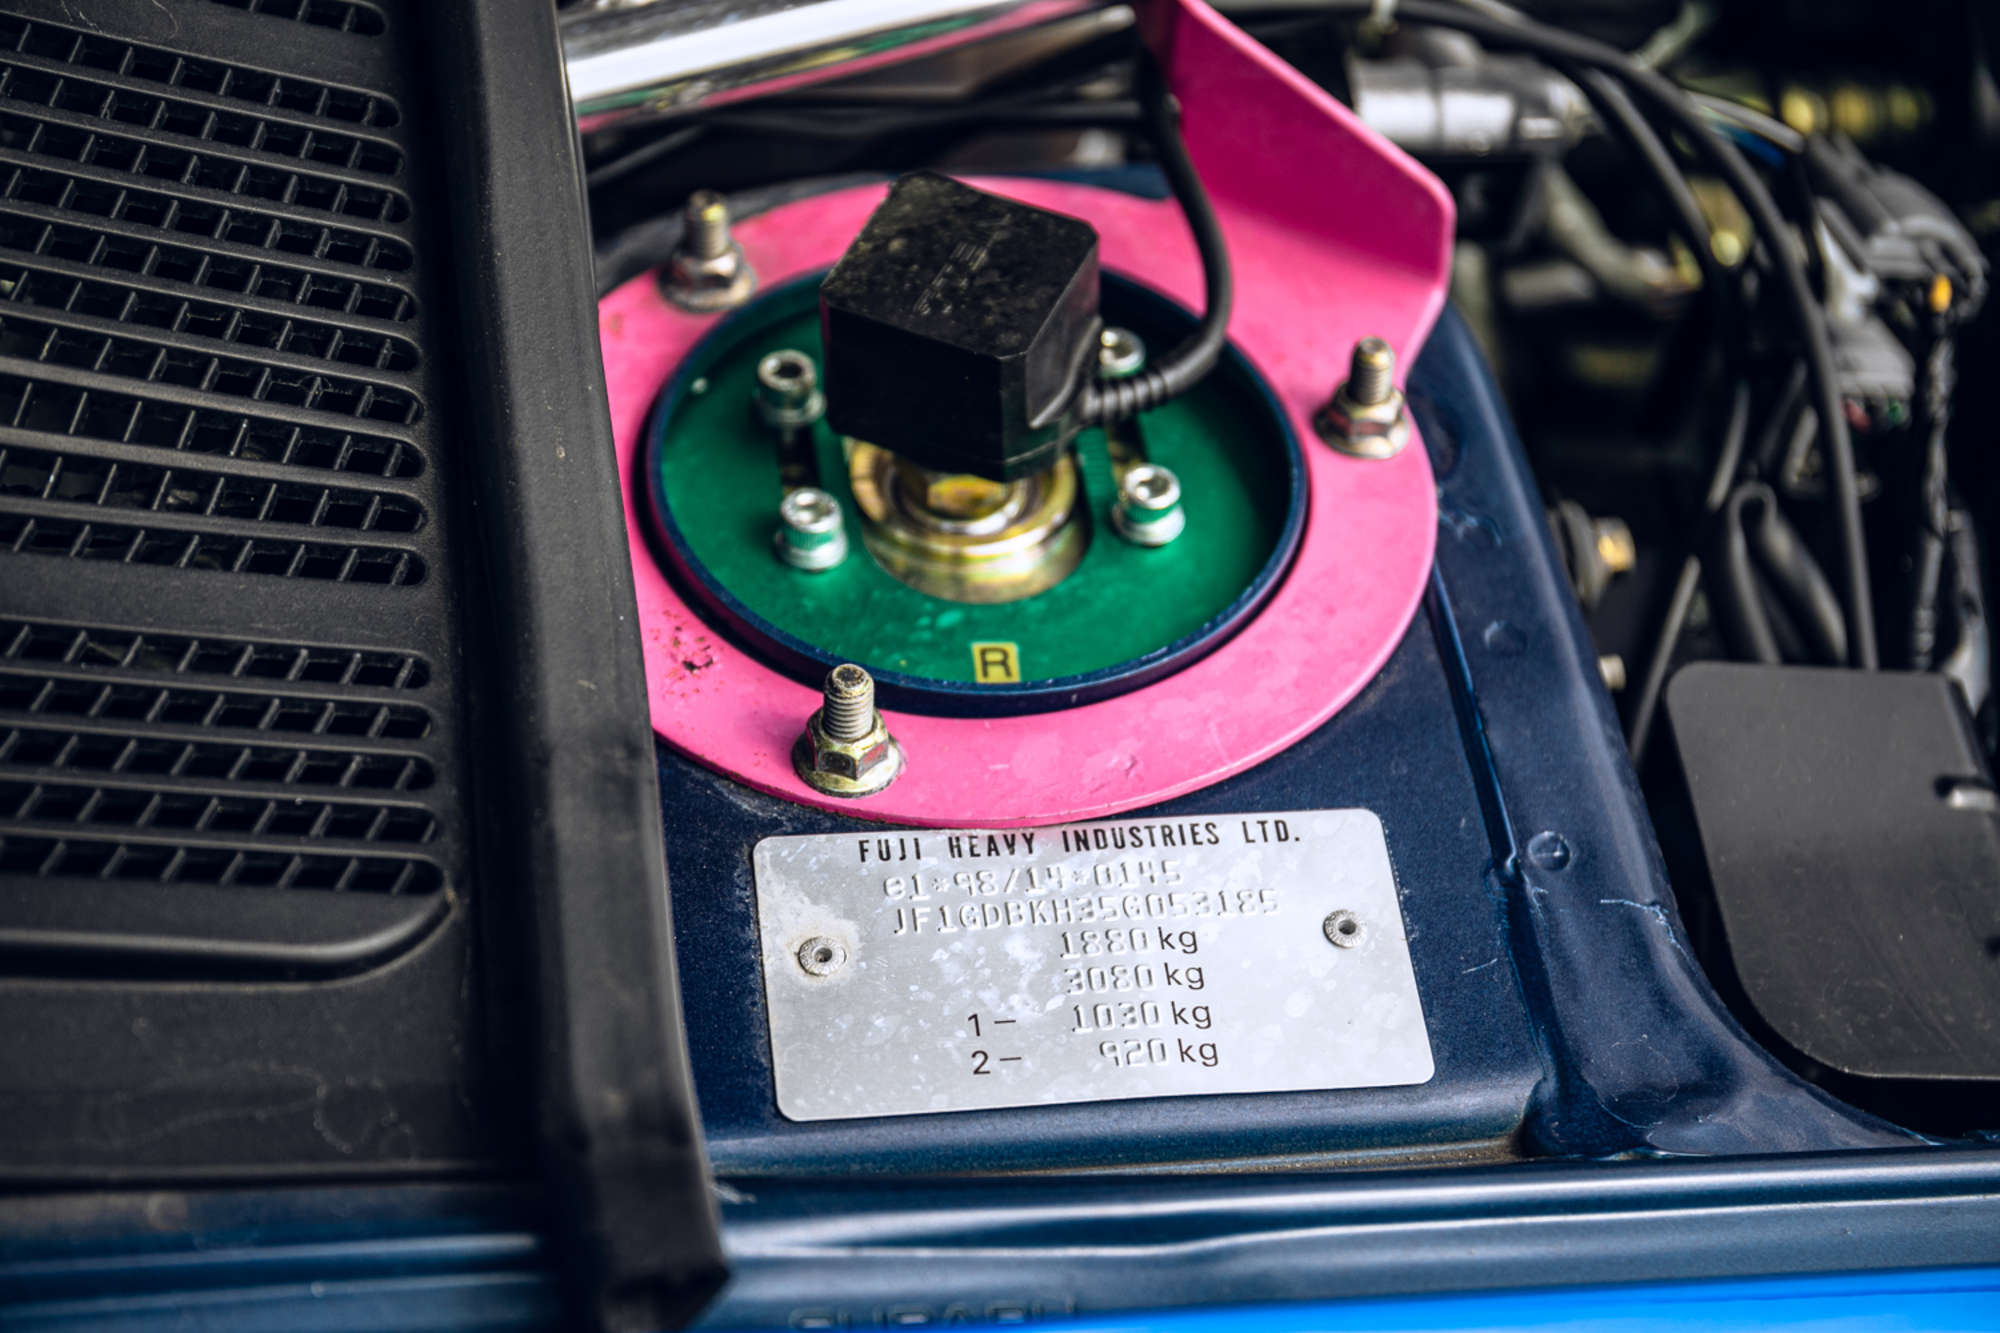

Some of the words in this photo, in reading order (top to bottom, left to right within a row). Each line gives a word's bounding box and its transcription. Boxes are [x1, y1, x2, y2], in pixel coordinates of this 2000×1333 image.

[980, 647, 1012, 678] R
[858, 838, 922, 863] FUJI
[947, 832, 1036, 859] HEAVY
[1062, 822, 1220, 853] INDUSTRIES
[1242, 820, 1301, 844] LTD.
[1060, 927, 1151, 959] 1880
[1158, 926, 1199, 954] kg
[1064, 964, 1156, 995] 3080
[1164, 962, 1205, 990] kg
[1072, 1001, 1162, 1034] 1030
[1171, 1001, 1212, 1030] kg
[1099, 1038, 1169, 1068] 920
[1178, 1038, 1219, 1067] kg
